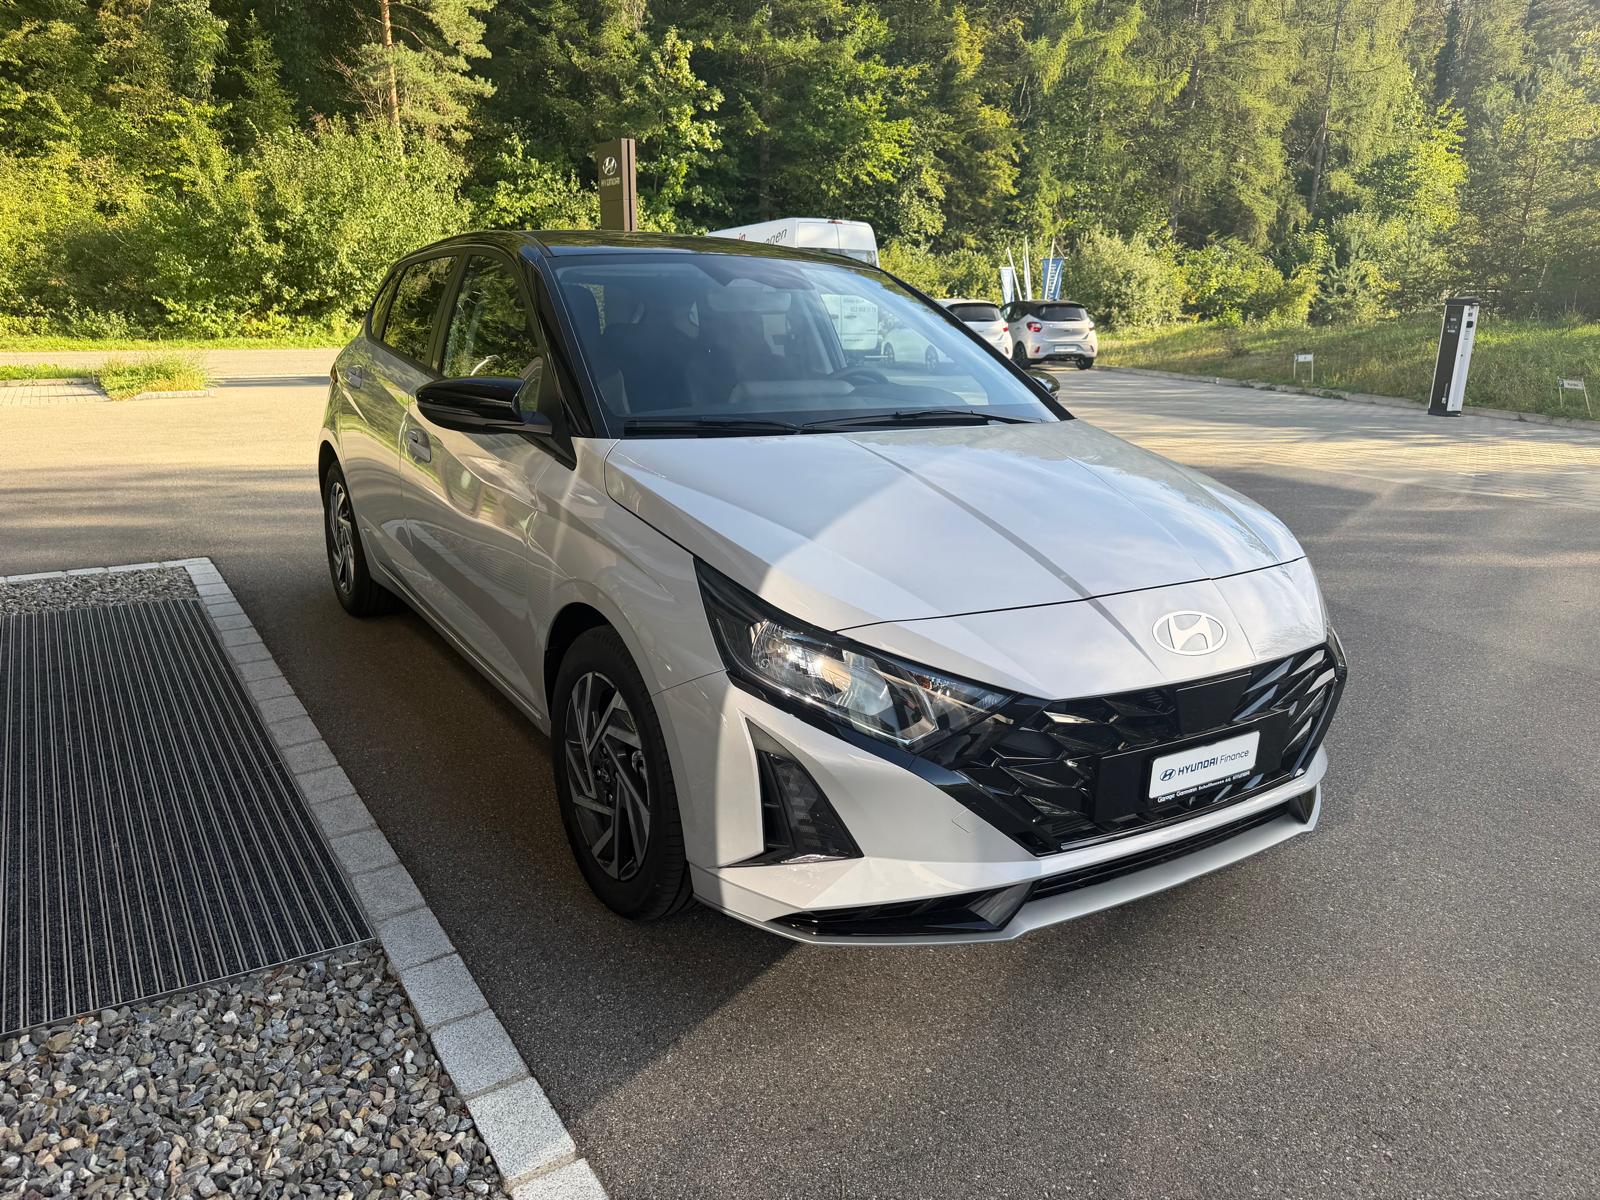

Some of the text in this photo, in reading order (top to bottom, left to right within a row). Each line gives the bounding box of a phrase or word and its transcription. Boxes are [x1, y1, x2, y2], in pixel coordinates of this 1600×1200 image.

[1178, 750, 1250, 776] HYUNDAI Finance
[1158, 794, 1175, 803] Garage
